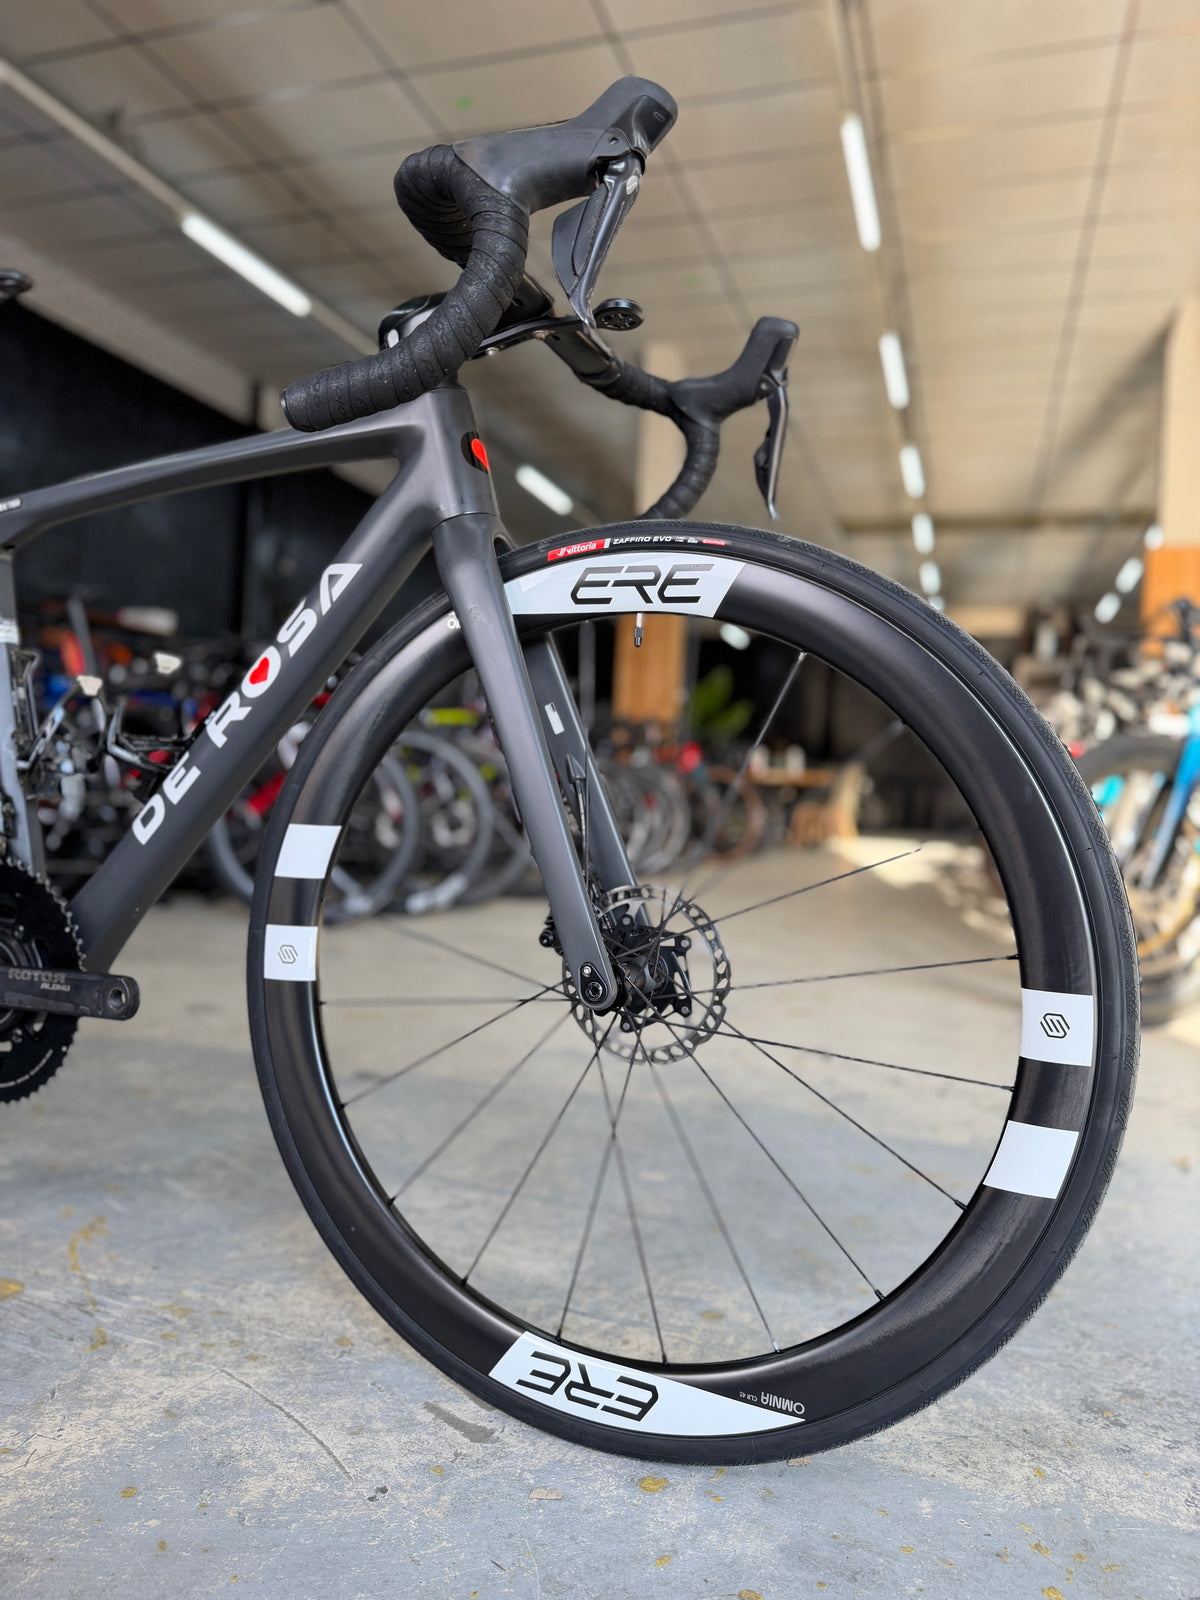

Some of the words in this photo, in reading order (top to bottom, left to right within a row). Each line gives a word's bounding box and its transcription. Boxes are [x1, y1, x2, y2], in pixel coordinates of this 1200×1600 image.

[570, 563, 715, 605] ERE
[132, 752, 201, 845] DE
[206, 563, 363, 748] ROSA
[8, 967, 66, 983] ROTOR
[515, 1351, 659, 1422] ERE
[761, 1391, 805, 1414] OMNIA
